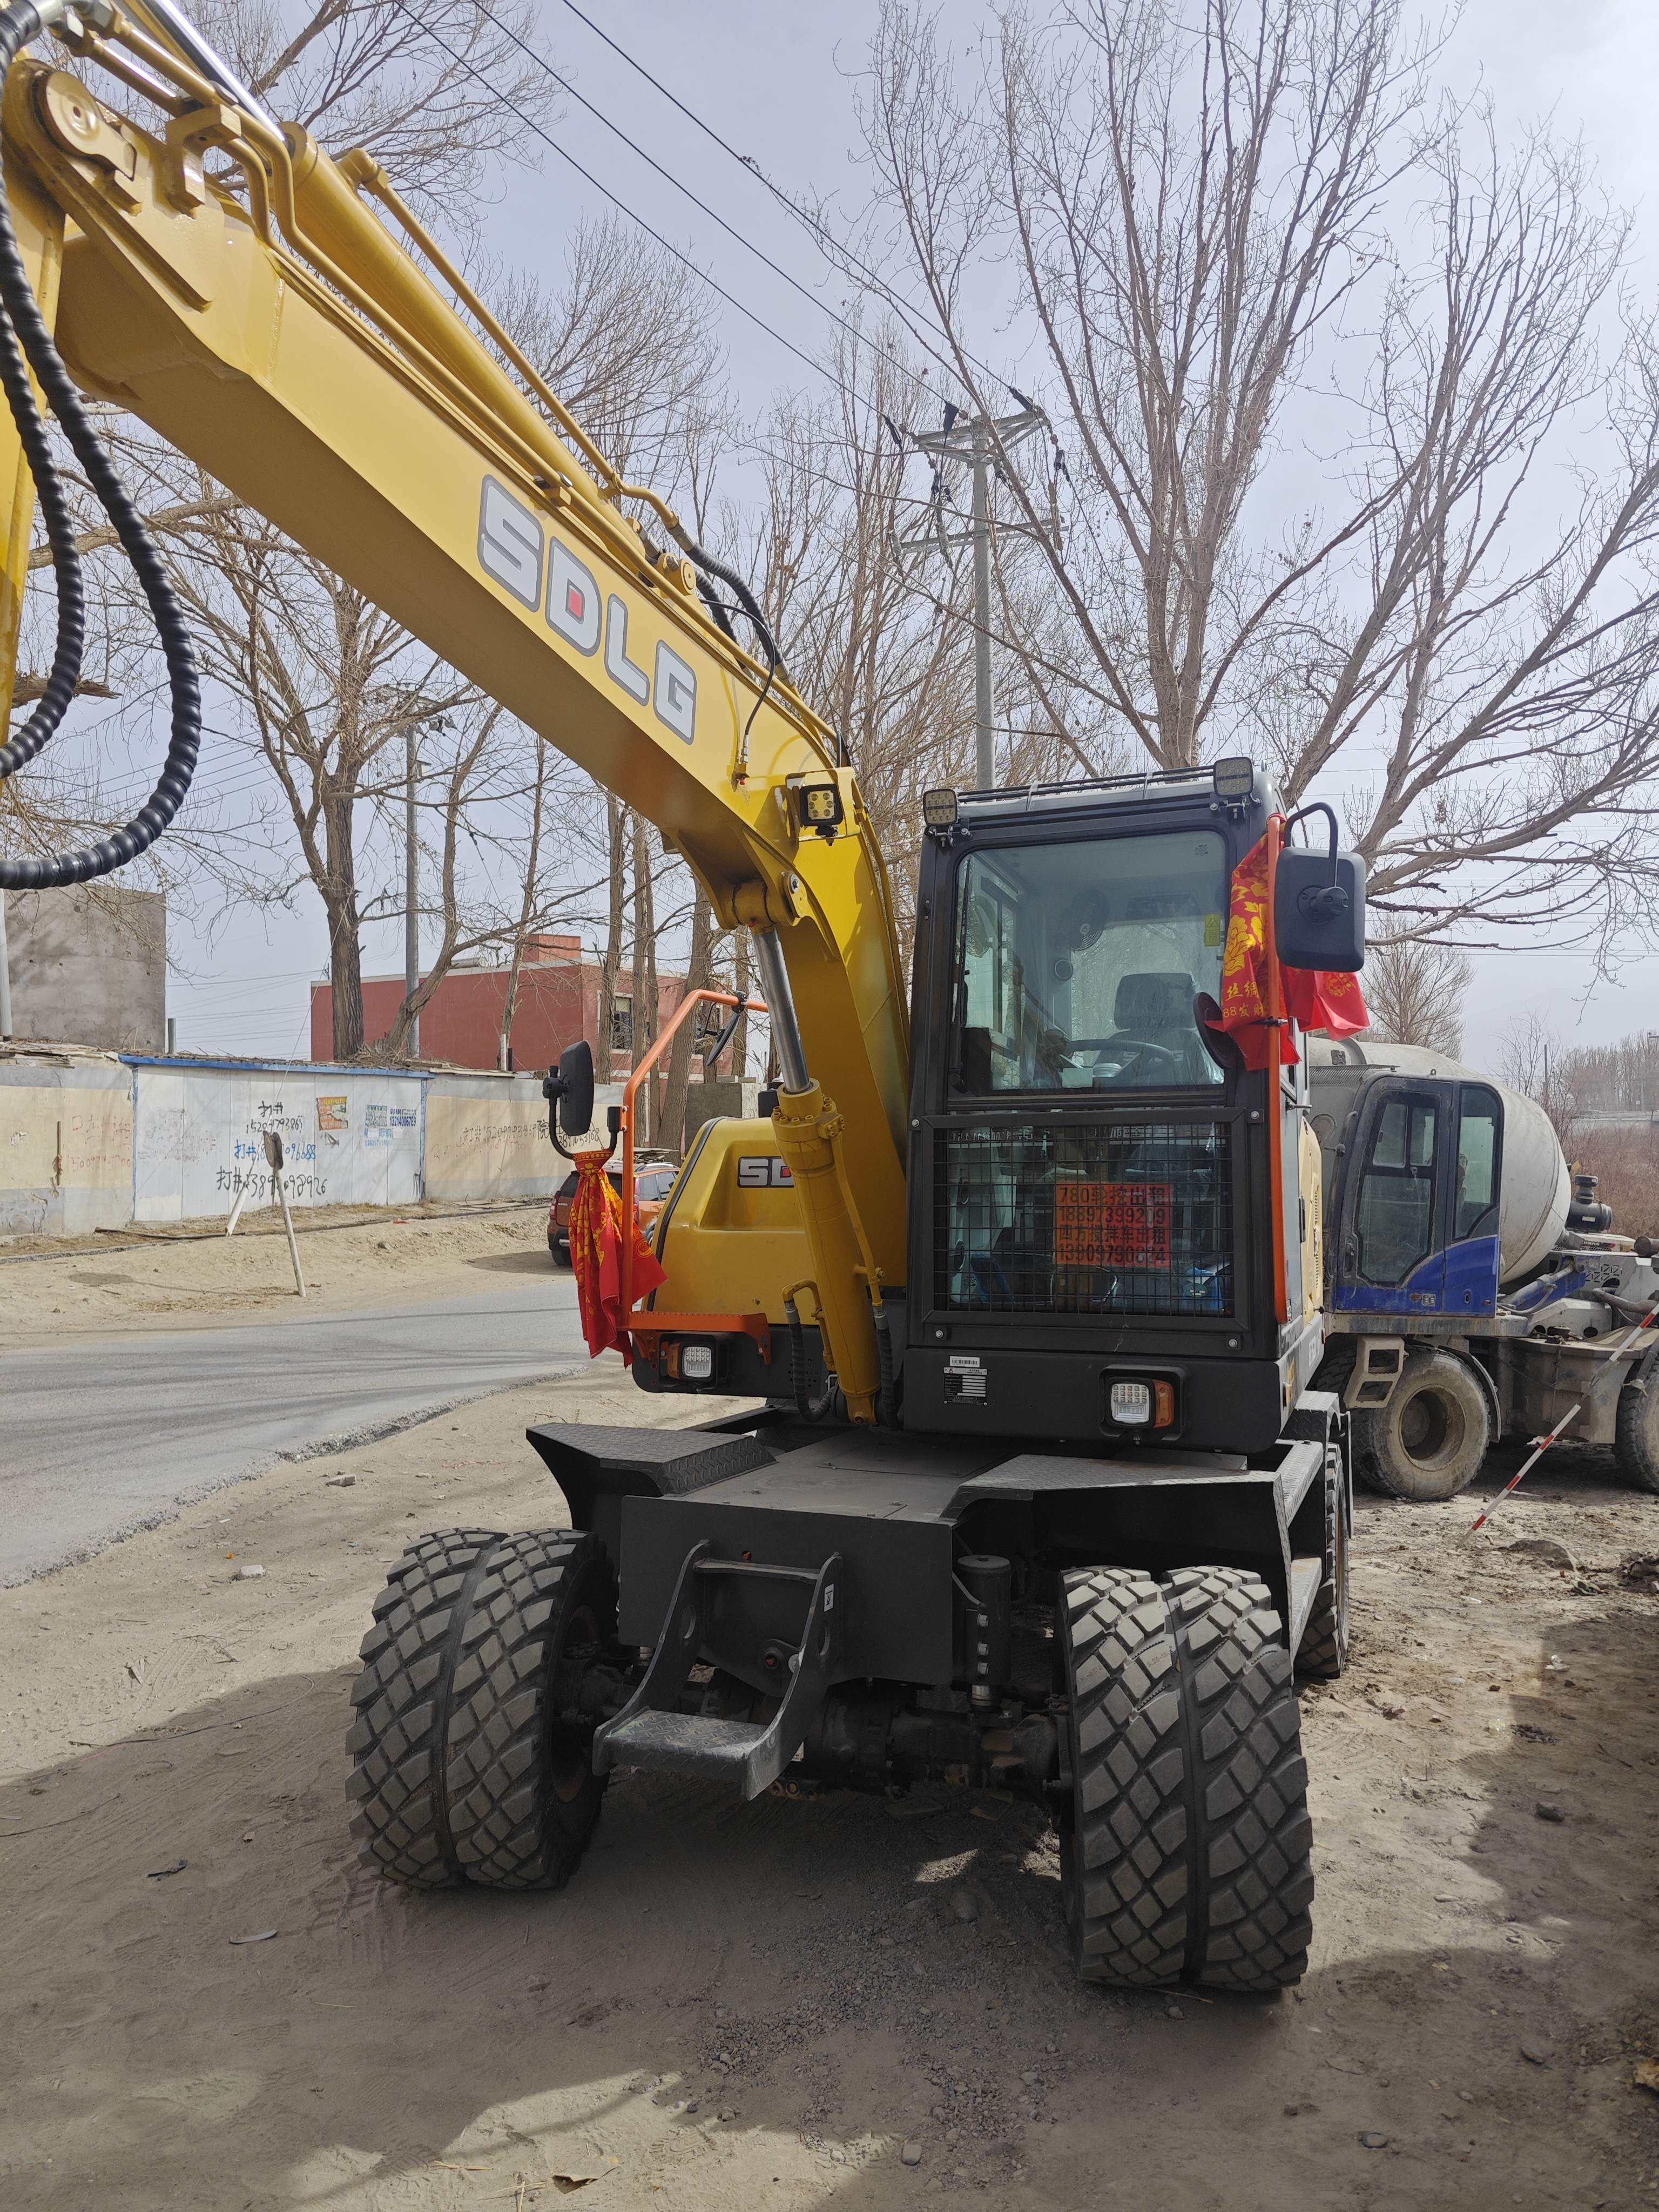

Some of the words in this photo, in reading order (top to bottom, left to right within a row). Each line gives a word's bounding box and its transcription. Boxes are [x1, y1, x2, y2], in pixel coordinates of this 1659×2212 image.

[477, 474, 697, 745] SDLG
[1225, 980, 1260, 1001] 丝绸
[258, 1100, 284, 1117] 打井
[738, 1156, 796, 1188] SD
[1059, 1185, 1166, 1205] 780轮挖出租
